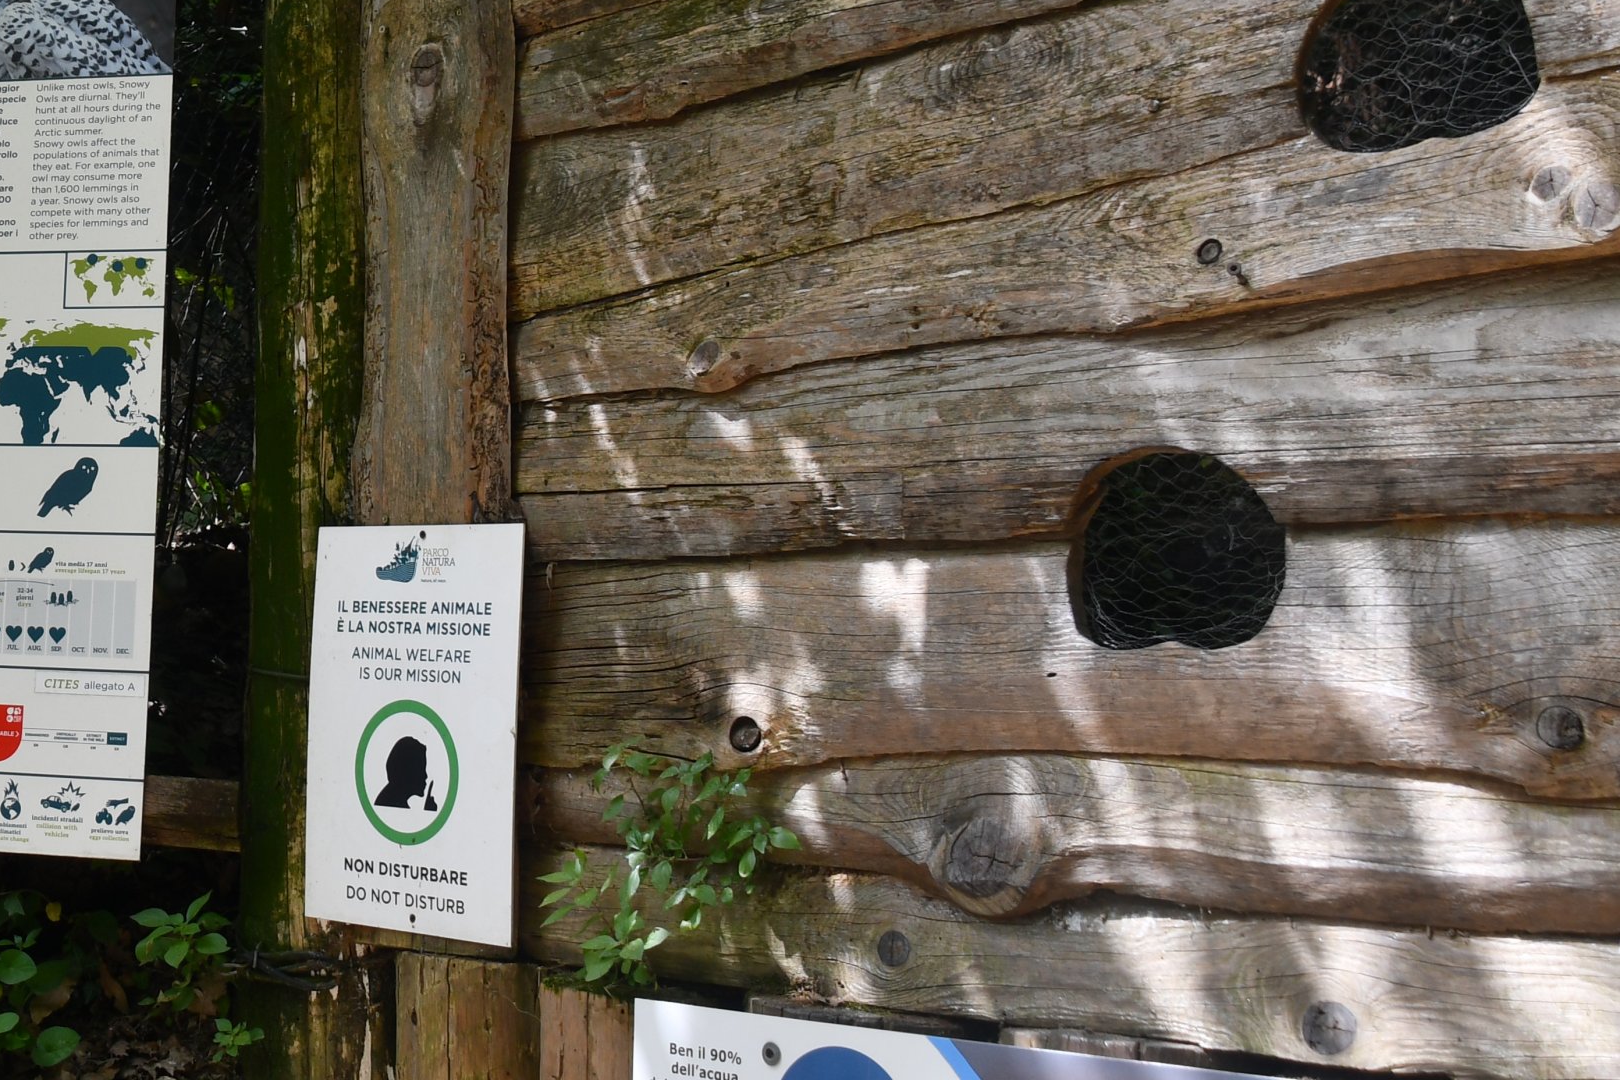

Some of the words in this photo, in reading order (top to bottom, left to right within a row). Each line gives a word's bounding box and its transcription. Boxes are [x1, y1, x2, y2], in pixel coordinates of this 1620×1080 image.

[36, 83, 64, 92] Unlike
[67, 82, 90, 90] most
[93, 82, 116, 90] owls,
[119, 81, 150, 90] Snowy
[36, 94, 59, 103] Owls
[78, 93, 111, 101] diurnal.
[423, 548, 449, 557] PARCO
[422, 558, 455, 566] NATURA
[422, 567, 441, 575] VIVA
[338, 600, 348, 613] IL
[353, 601, 427, 614] BENESSERE
[431, 602, 492, 615] ANIMALE
[337, 617, 344, 632] È
[348, 621, 364, 632] LA
[369, 621, 421, 634] NOSTRA
[426, 622, 490, 636] MISSIONE
[352, 647, 401, 660] ANIMAL
[406, 649, 471, 663] WELFARE
[359, 667, 370, 679] IS
[375, 668, 402, 681] OUR
[406, 669, 461, 683] MISSION
[44, 678, 79, 690] CITES
[84, 681, 124, 693] allegato
[128, 682, 135, 692] A
[344, 857, 374, 874] NON
[379, 862, 468, 886] DISTURBARE
[346, 885, 366, 900] DO
[371, 889, 400, 905] NOT
[405, 893, 464, 914] DISTURB
[669, 1042, 693, 1058] Ben
[698, 1046, 705, 1059] il
[711, 1048, 742, 1065] 90%
